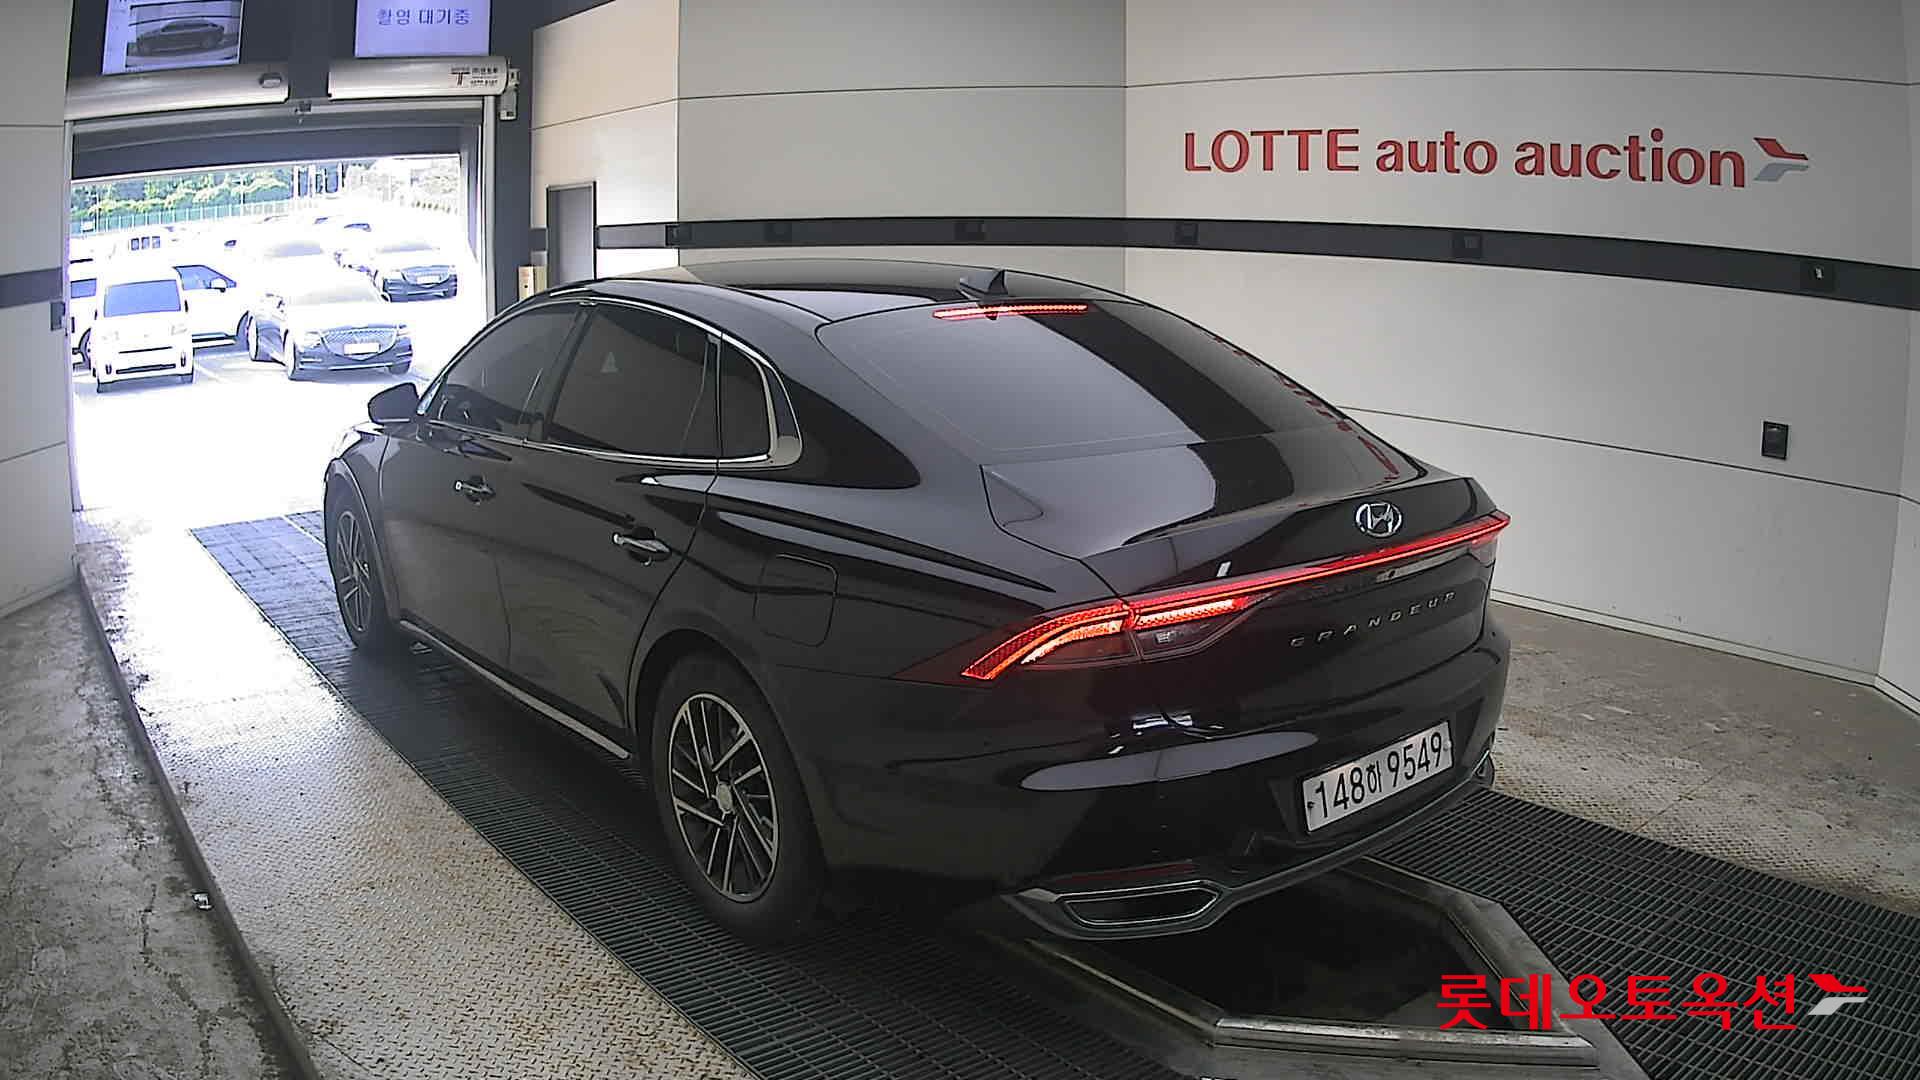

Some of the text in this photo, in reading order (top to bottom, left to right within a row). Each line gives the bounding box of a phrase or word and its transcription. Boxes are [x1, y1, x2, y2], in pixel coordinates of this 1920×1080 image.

[419, 8, 472, 25] 대기중
[1184, 128, 1745, 188] LOTTE auto auction
[1290, 591, 1456, 648] GRANDEUR
[1387, 732, 1442, 787] 9549
